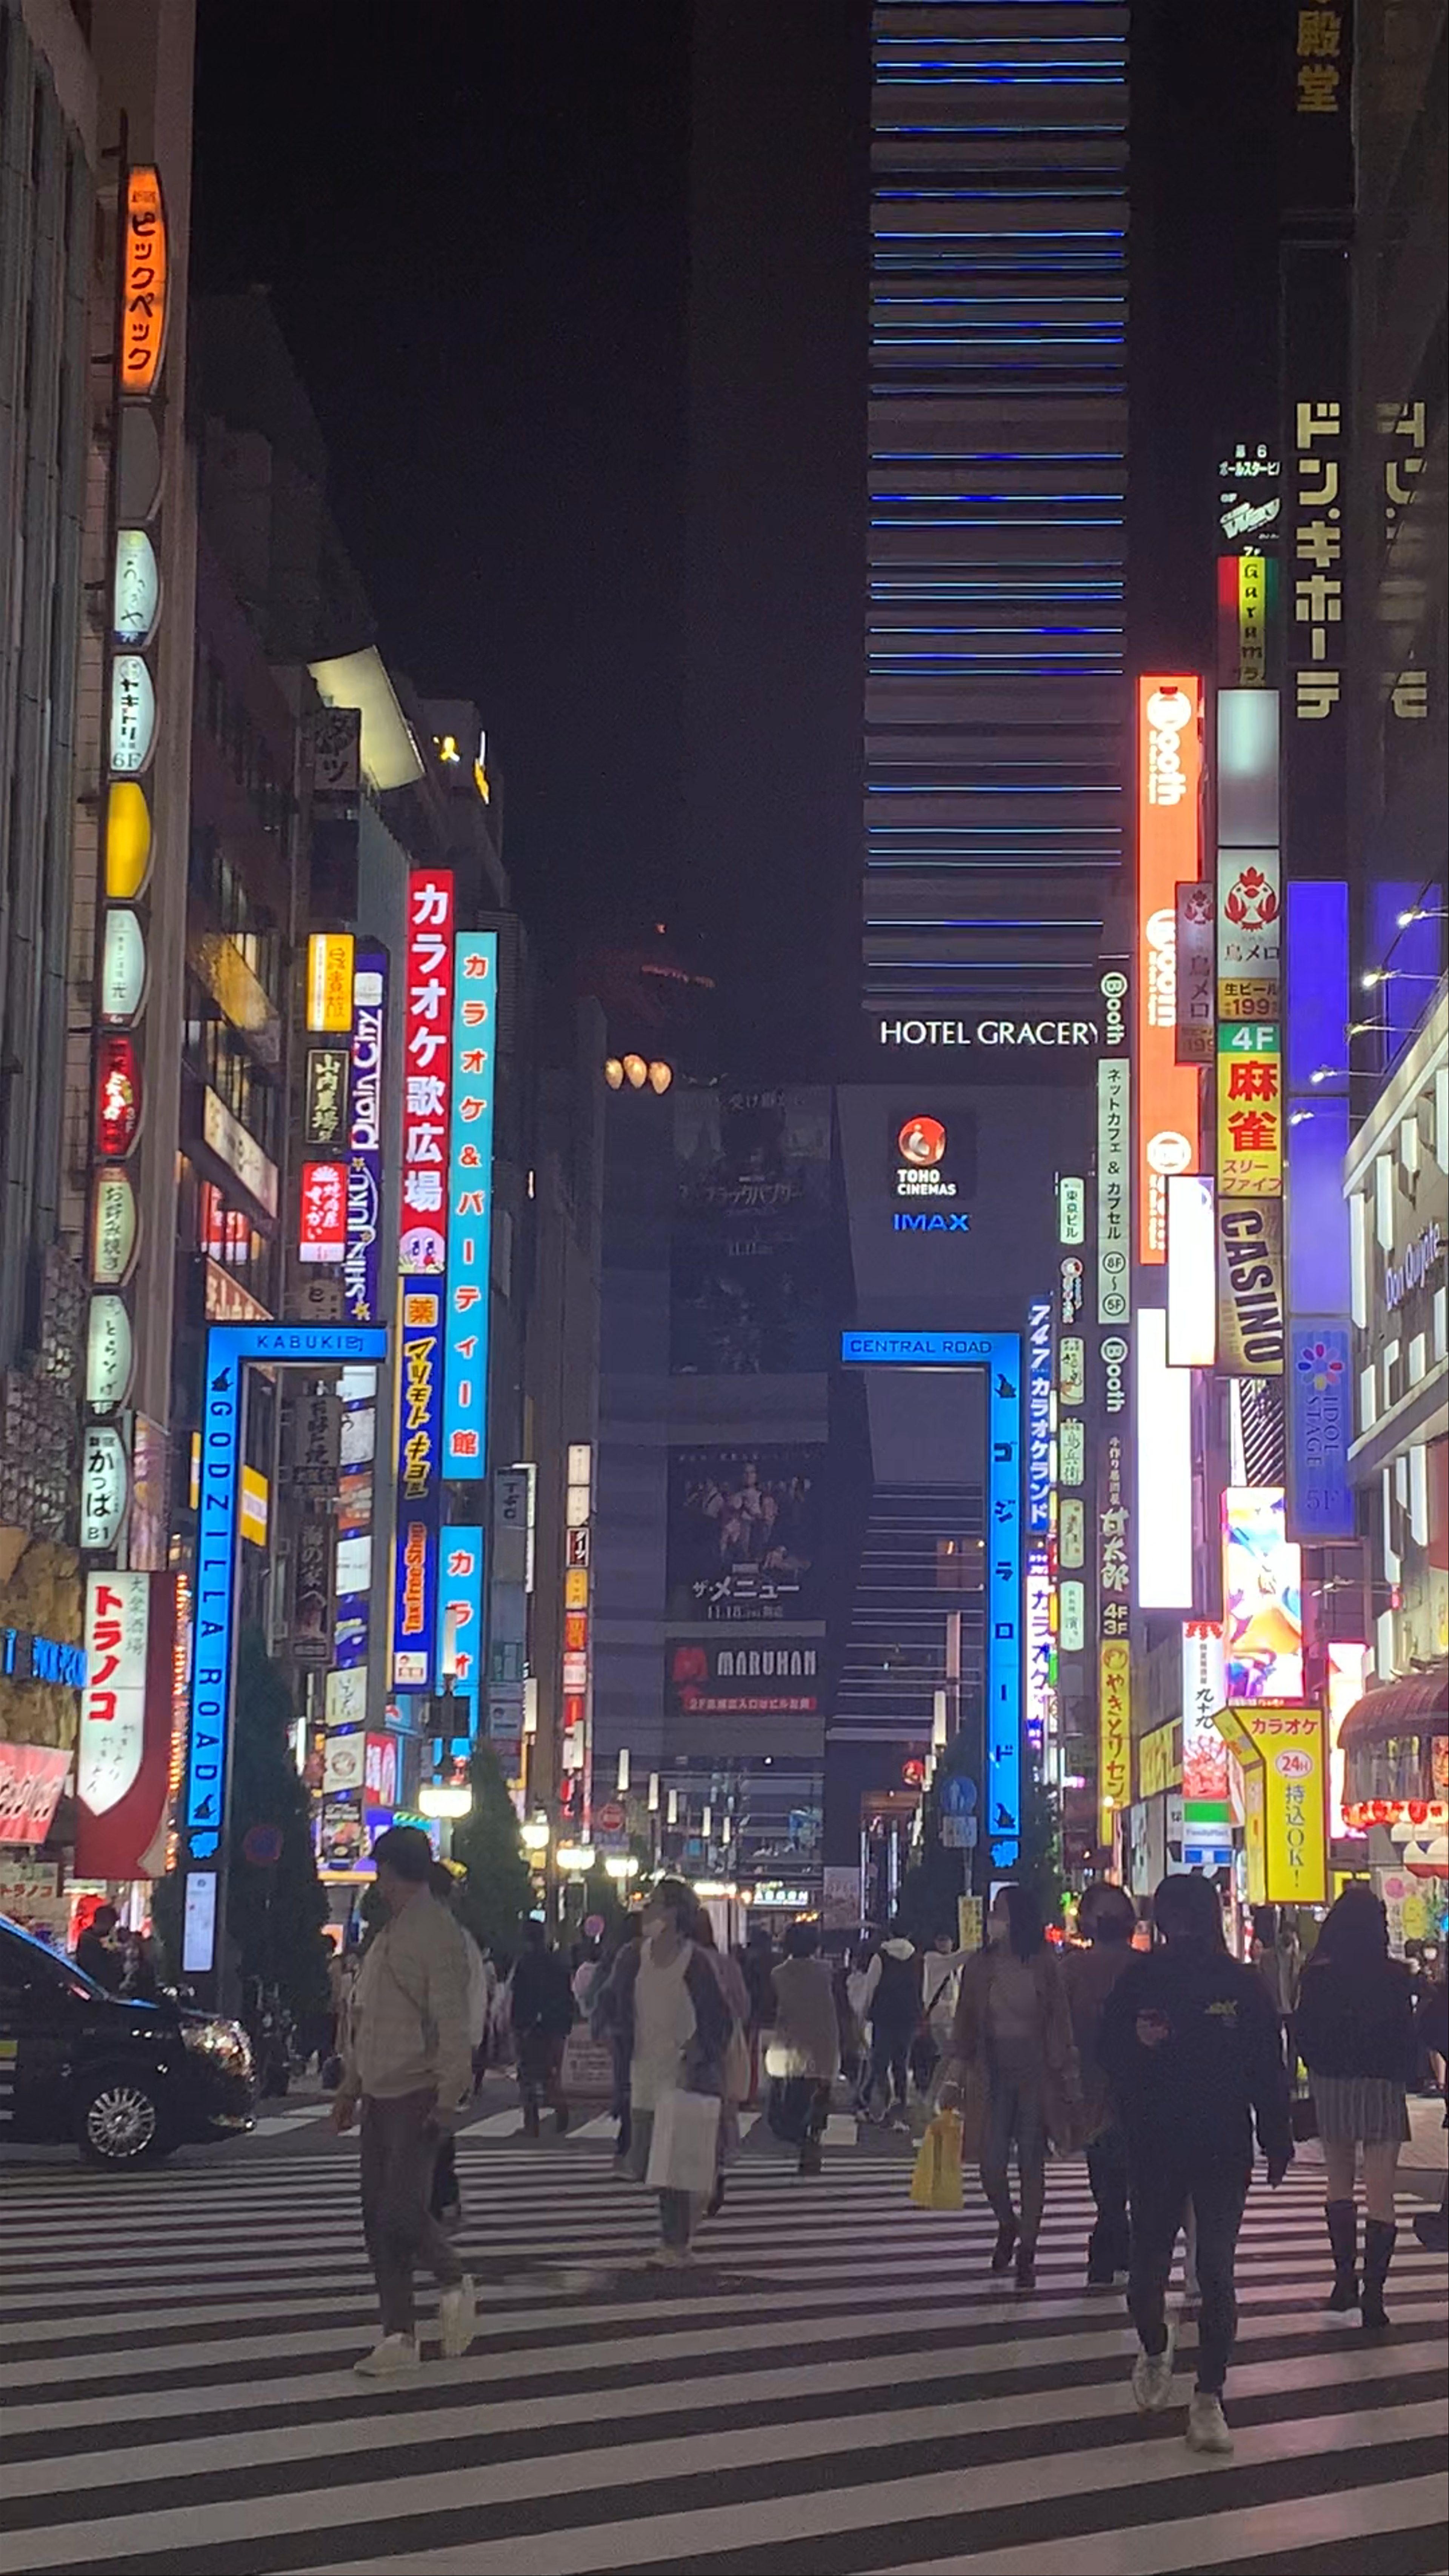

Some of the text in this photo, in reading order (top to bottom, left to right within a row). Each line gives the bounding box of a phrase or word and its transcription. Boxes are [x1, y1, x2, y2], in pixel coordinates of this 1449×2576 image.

[1297, 0, 1341, 112] 殿堂
[113, 752, 142, 768] 6F
[880, 1021, 1098, 1045] HOTEL GRACERY
[1232, 1027, 1275, 1050] 4F
[404, 884, 449, 1214] カラオケ歌広場
[1227, 1061, 1278, 1152] 麻雀
[898, 1170, 940, 1183] TOHO
[898, 1184, 957, 1195] CINEMAS
[450, 955, 489, 1457] カラオケ&パーティー館
[345, 1173, 375, 1297] SHINJUKU
[894, 1214, 969, 1231] IMAX
[1221, 1210, 1284, 1363] CASINO
[851, 1340, 992, 1354] CENTRAL ROAD
[1030, 1377, 1050, 1524] カラオケランド
[88, 1527, 109, 1540] B1
[1100, 1507, 1130, 1591] 甘太郎
[195, 1401, 232, 1781] GODZILLA ROAD
[693, 1576, 800, 1602] ザ・メニュー
[993, 1442, 1018, 1764] ゴジラロード
[1104, 1603, 1128, 1618] 4F
[1104, 1621, 1128, 1635] 3F
[88, 1585, 123, 1721] トラノコ
[717, 1651, 816, 1676] MARUHAN
[1195, 1688, 1214, 1729] 九十九
[1251, 1718, 1318, 1735] カラオケ
[1281, 1755, 1308, 1771] 24H
[1285, 1785, 1306, 1888] 持込OK!
